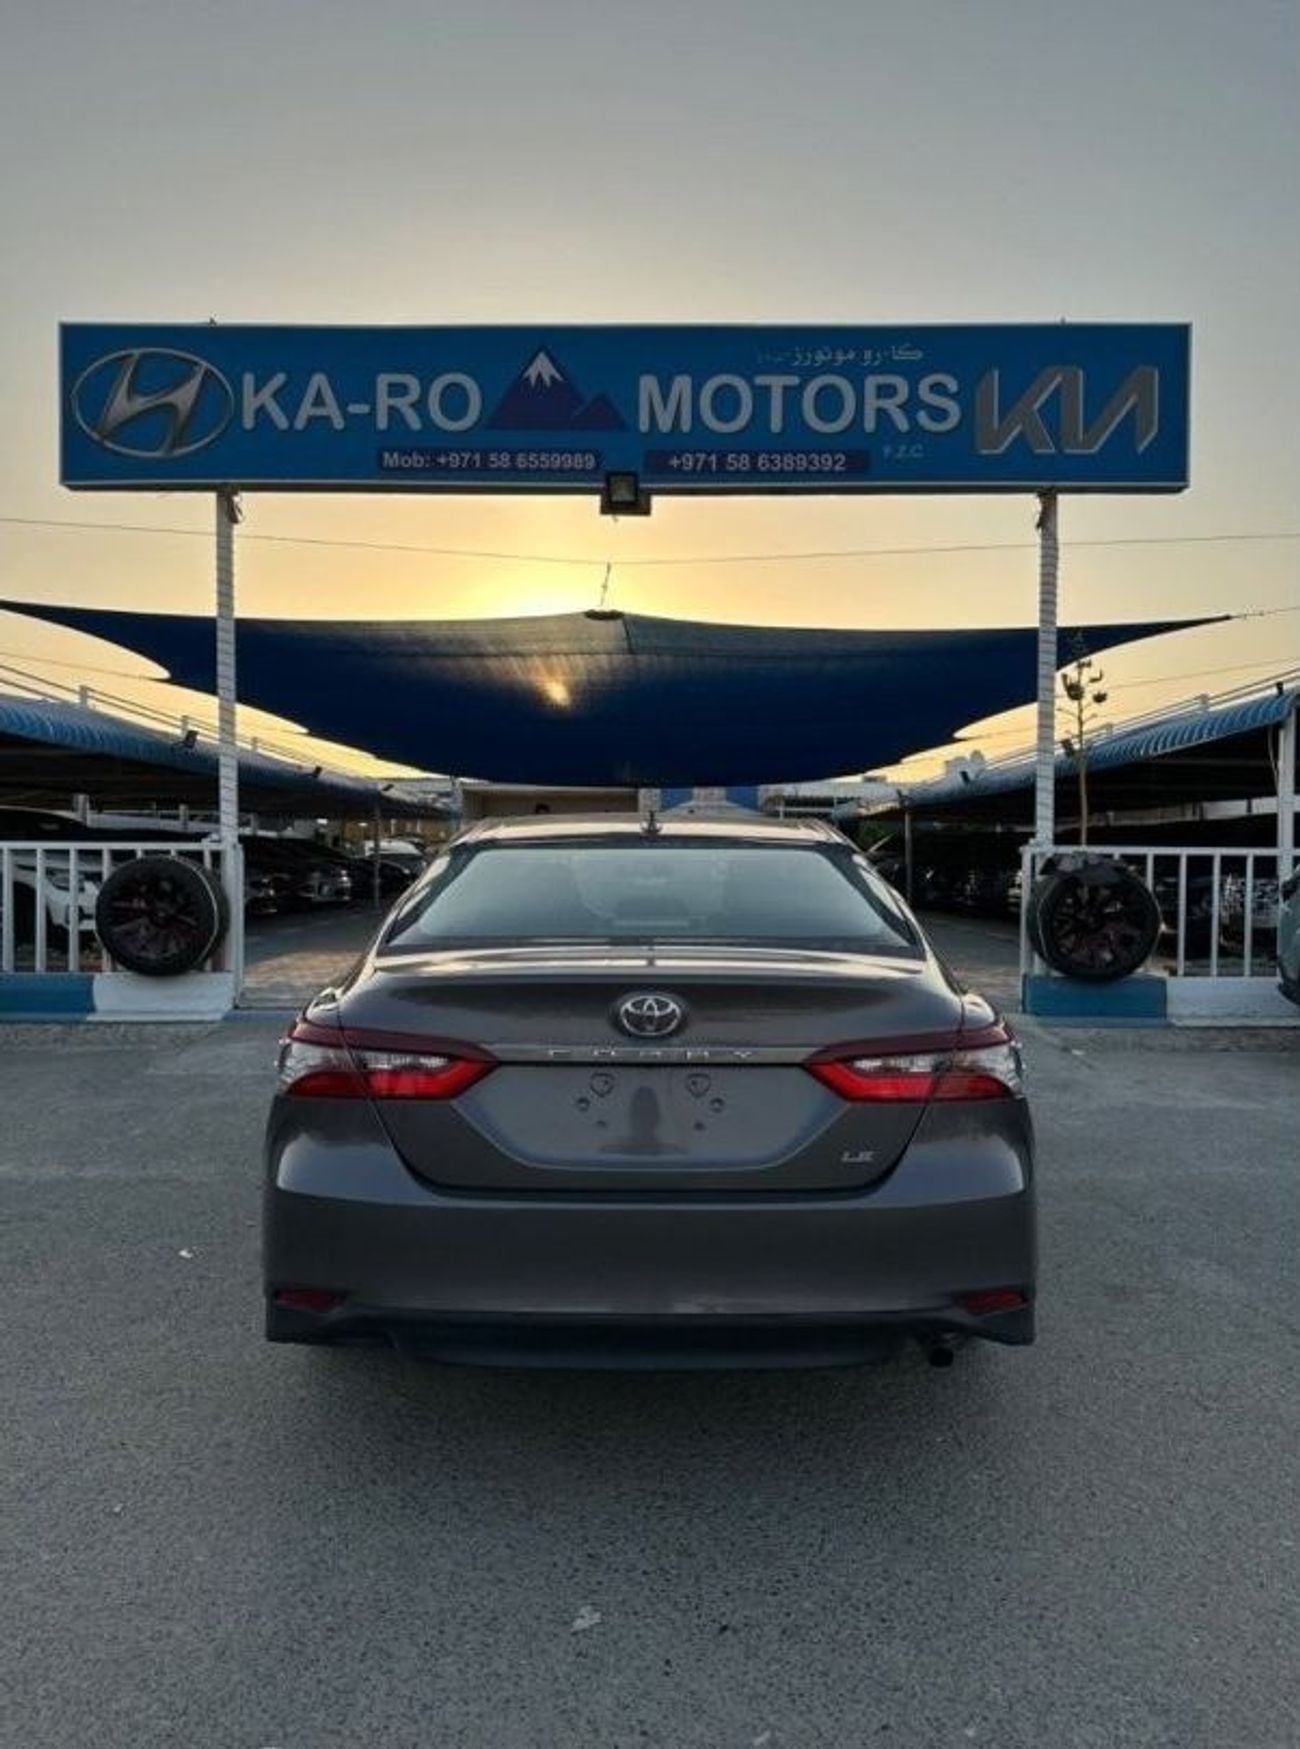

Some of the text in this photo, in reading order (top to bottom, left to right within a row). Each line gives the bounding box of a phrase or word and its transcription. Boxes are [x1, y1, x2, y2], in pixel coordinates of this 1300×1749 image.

[242, 372, 959, 434] KA-RO MOTORS
[382, 451, 431, 468] Mob:
[436, 452, 481, 468] +971
[489, 453, 511, 468] 58
[669, 453, 716, 471] +971
[726, 453, 749, 471] 58
